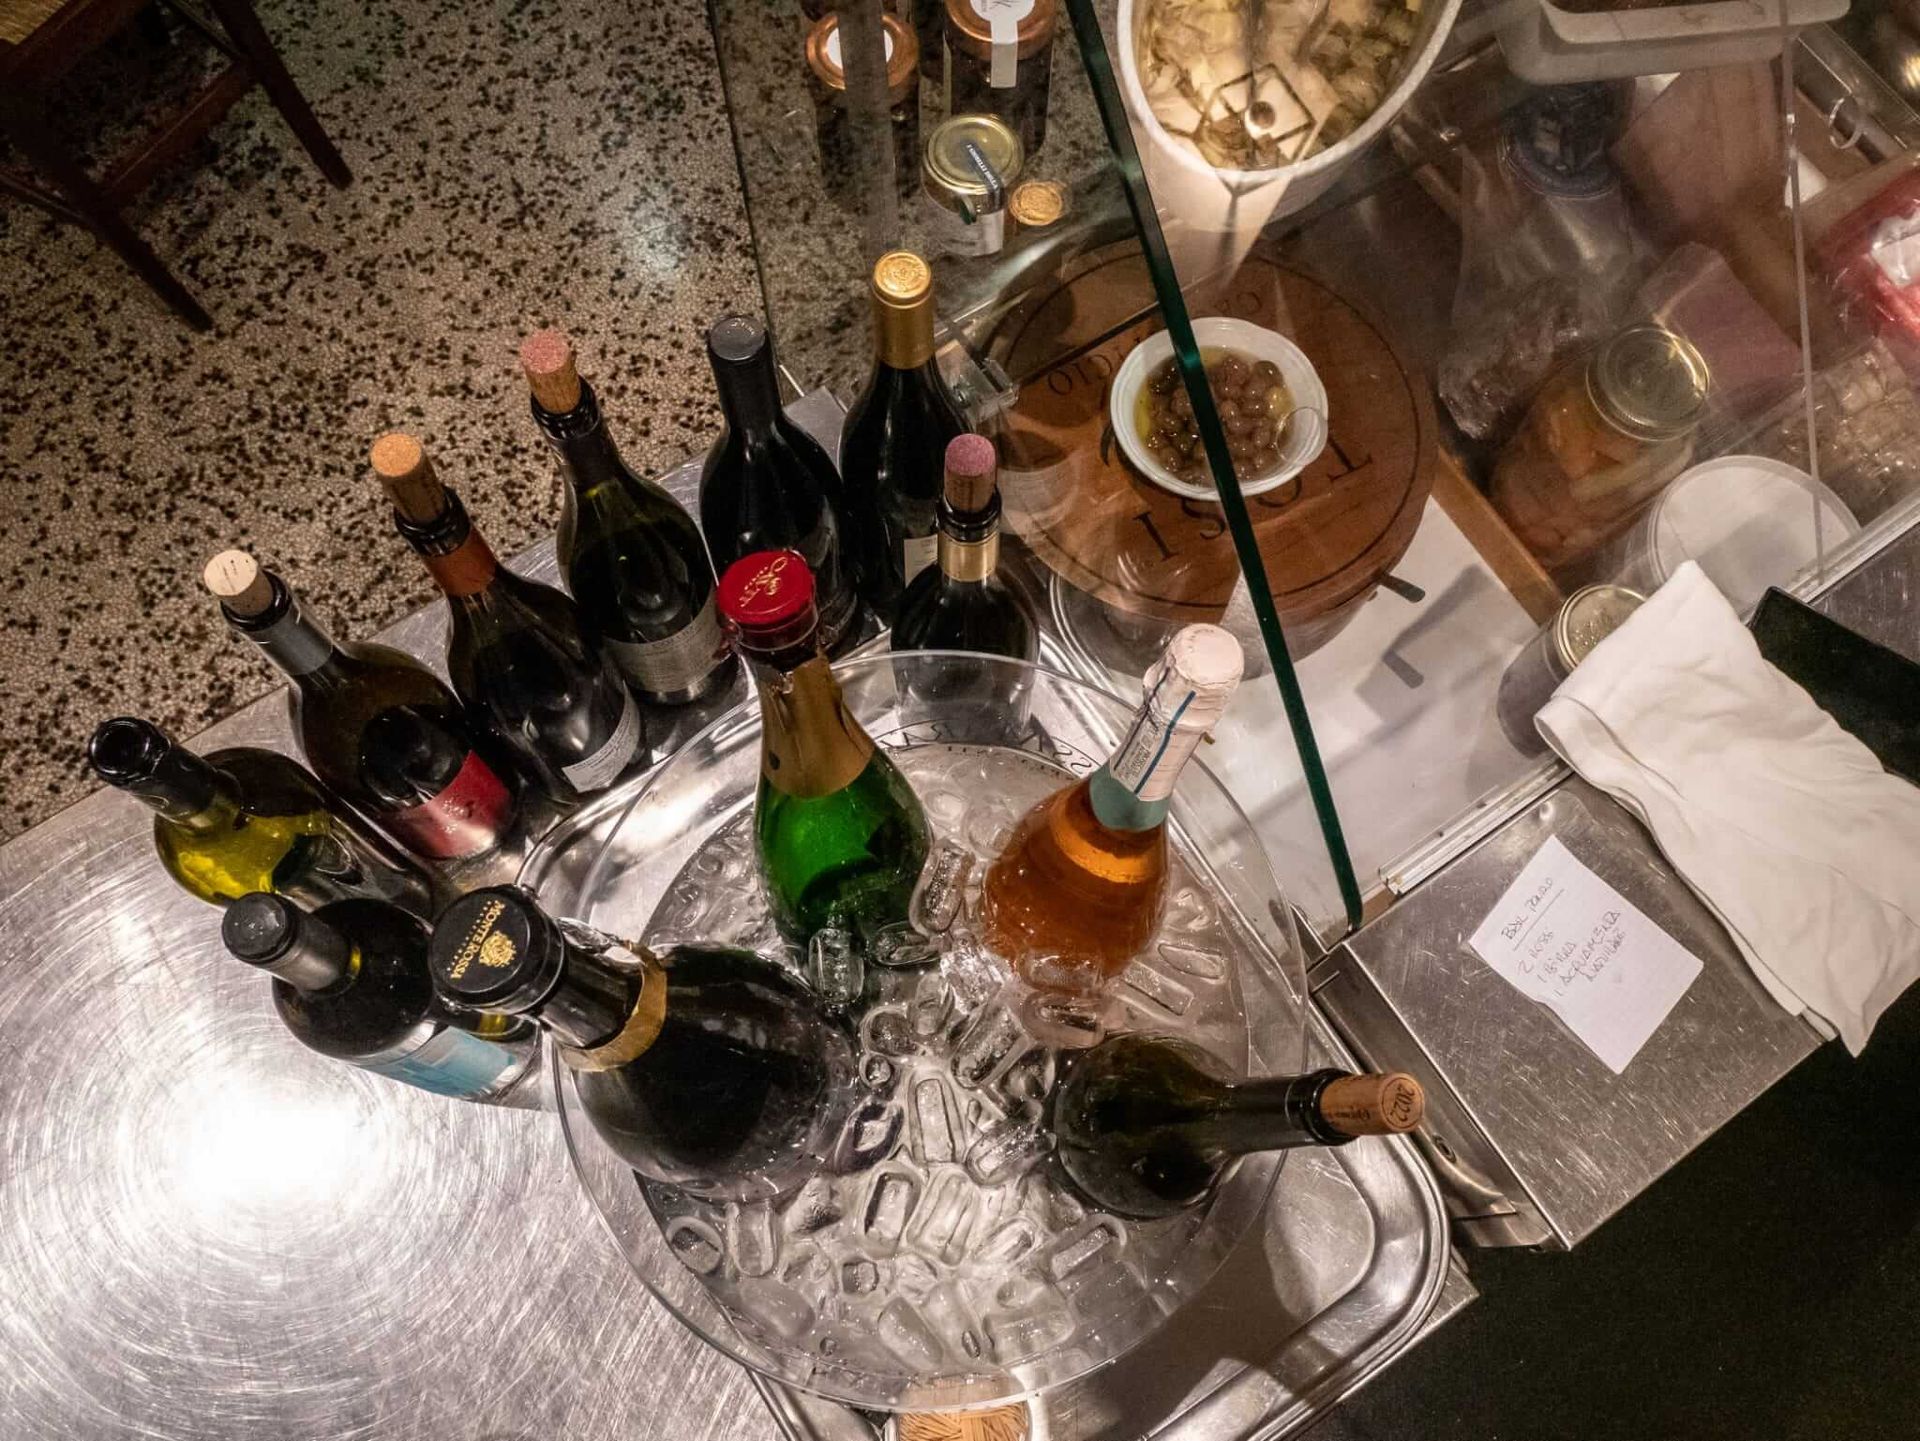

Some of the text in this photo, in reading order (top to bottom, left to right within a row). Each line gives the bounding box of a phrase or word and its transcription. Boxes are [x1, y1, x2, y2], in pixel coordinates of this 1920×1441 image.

[450, 900, 506, 978] MONTE ROSSA
[1389, 1083, 1416, 1122] 2022
